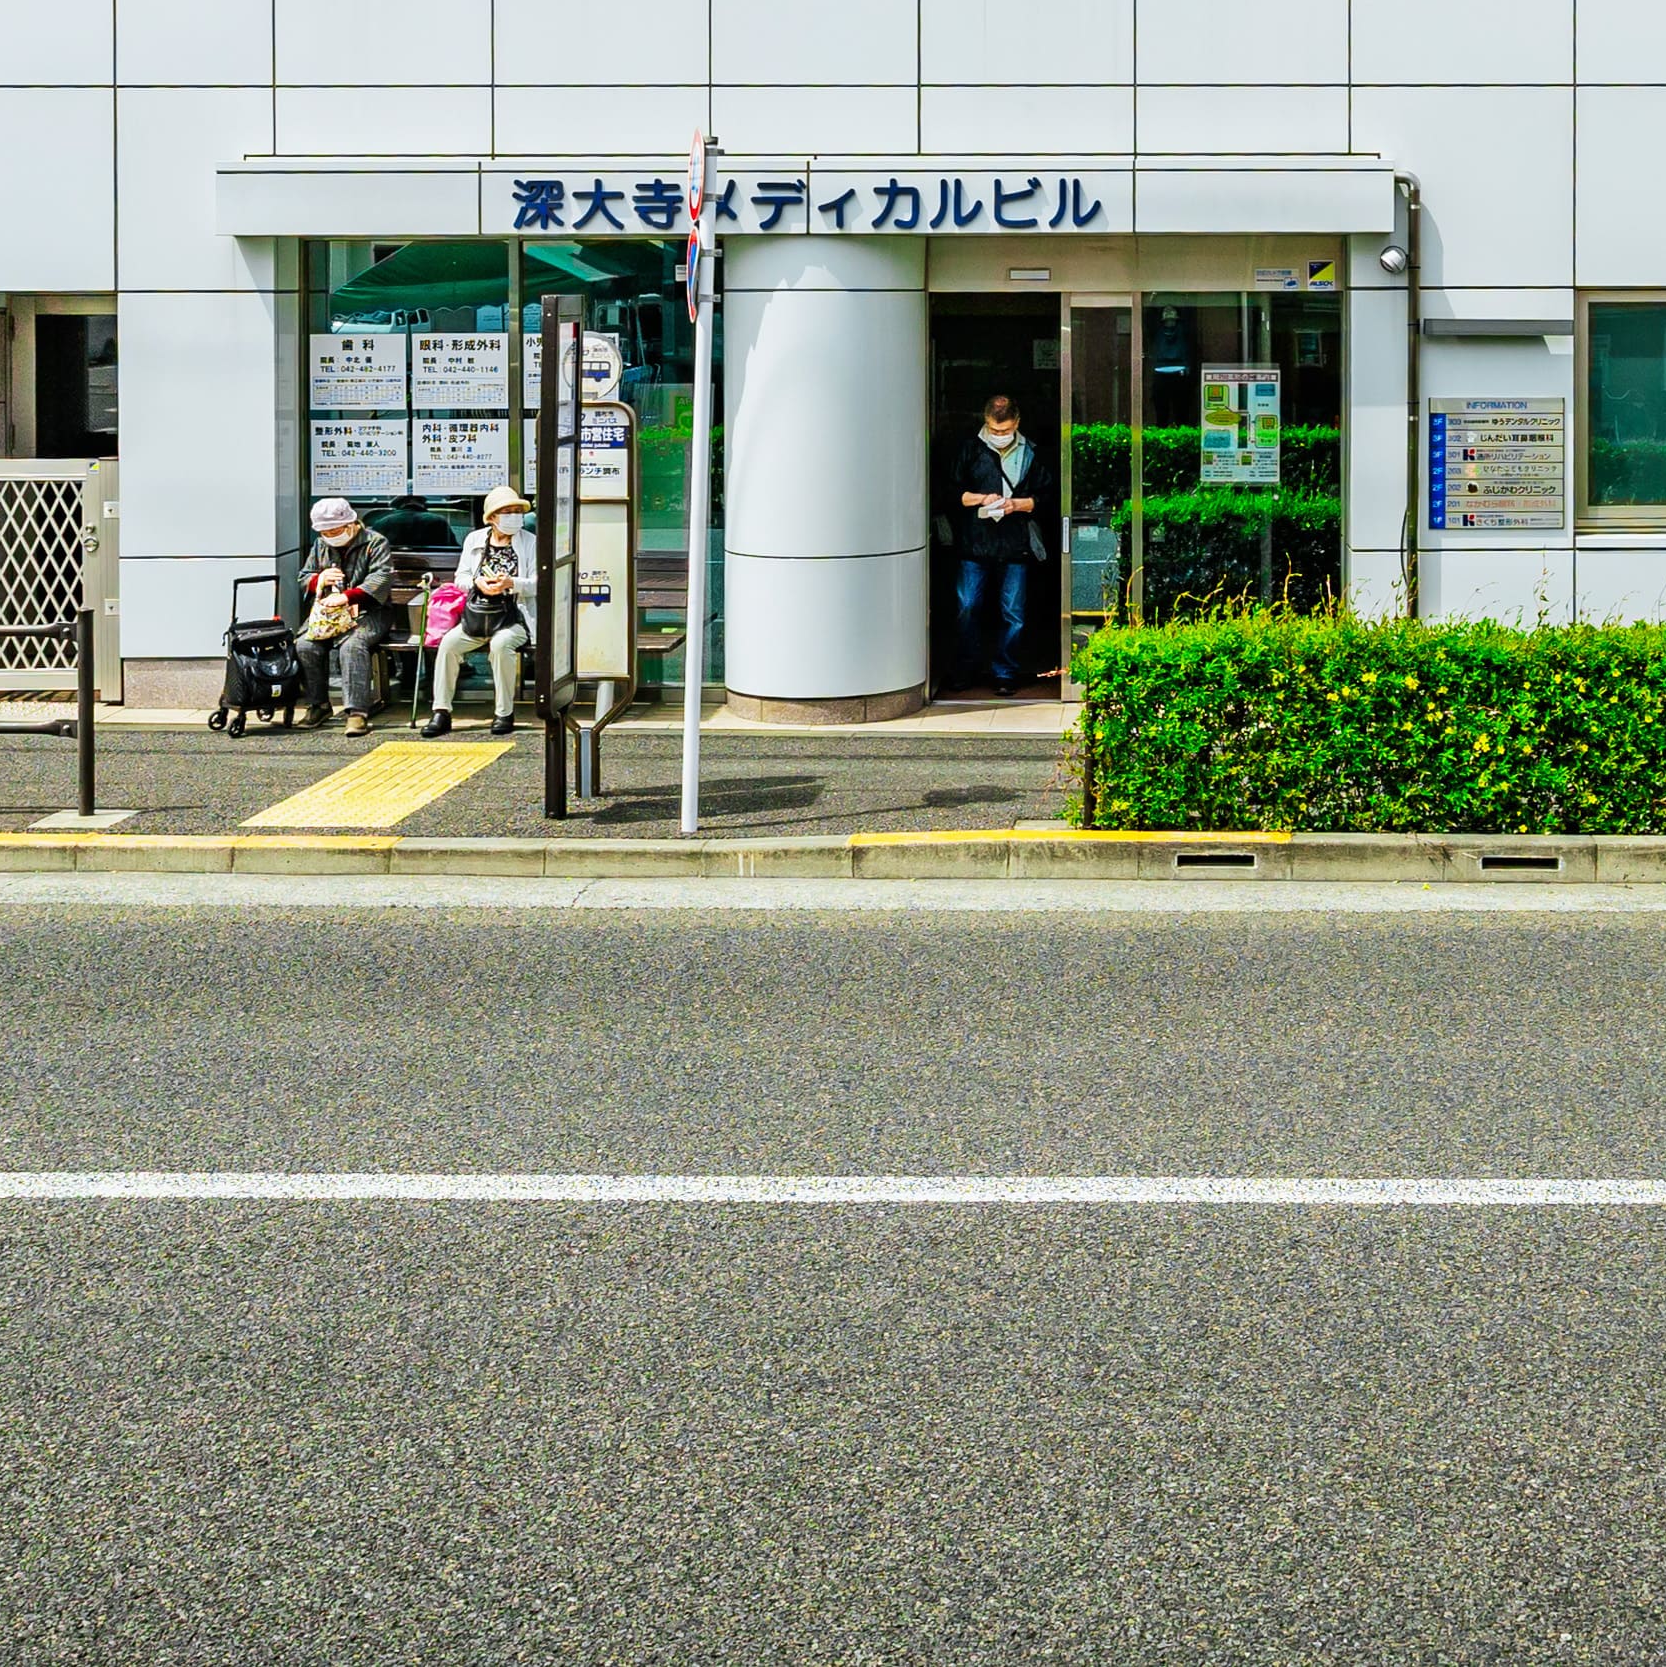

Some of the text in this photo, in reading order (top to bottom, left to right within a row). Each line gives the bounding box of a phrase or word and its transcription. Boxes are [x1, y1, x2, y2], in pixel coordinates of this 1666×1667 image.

[419, 338, 501, 351] 眼科・形成外科
[1465, 401, 1528, 410] INFORMATION
[1483, 485, 1557, 494] ふじかわクリニック
